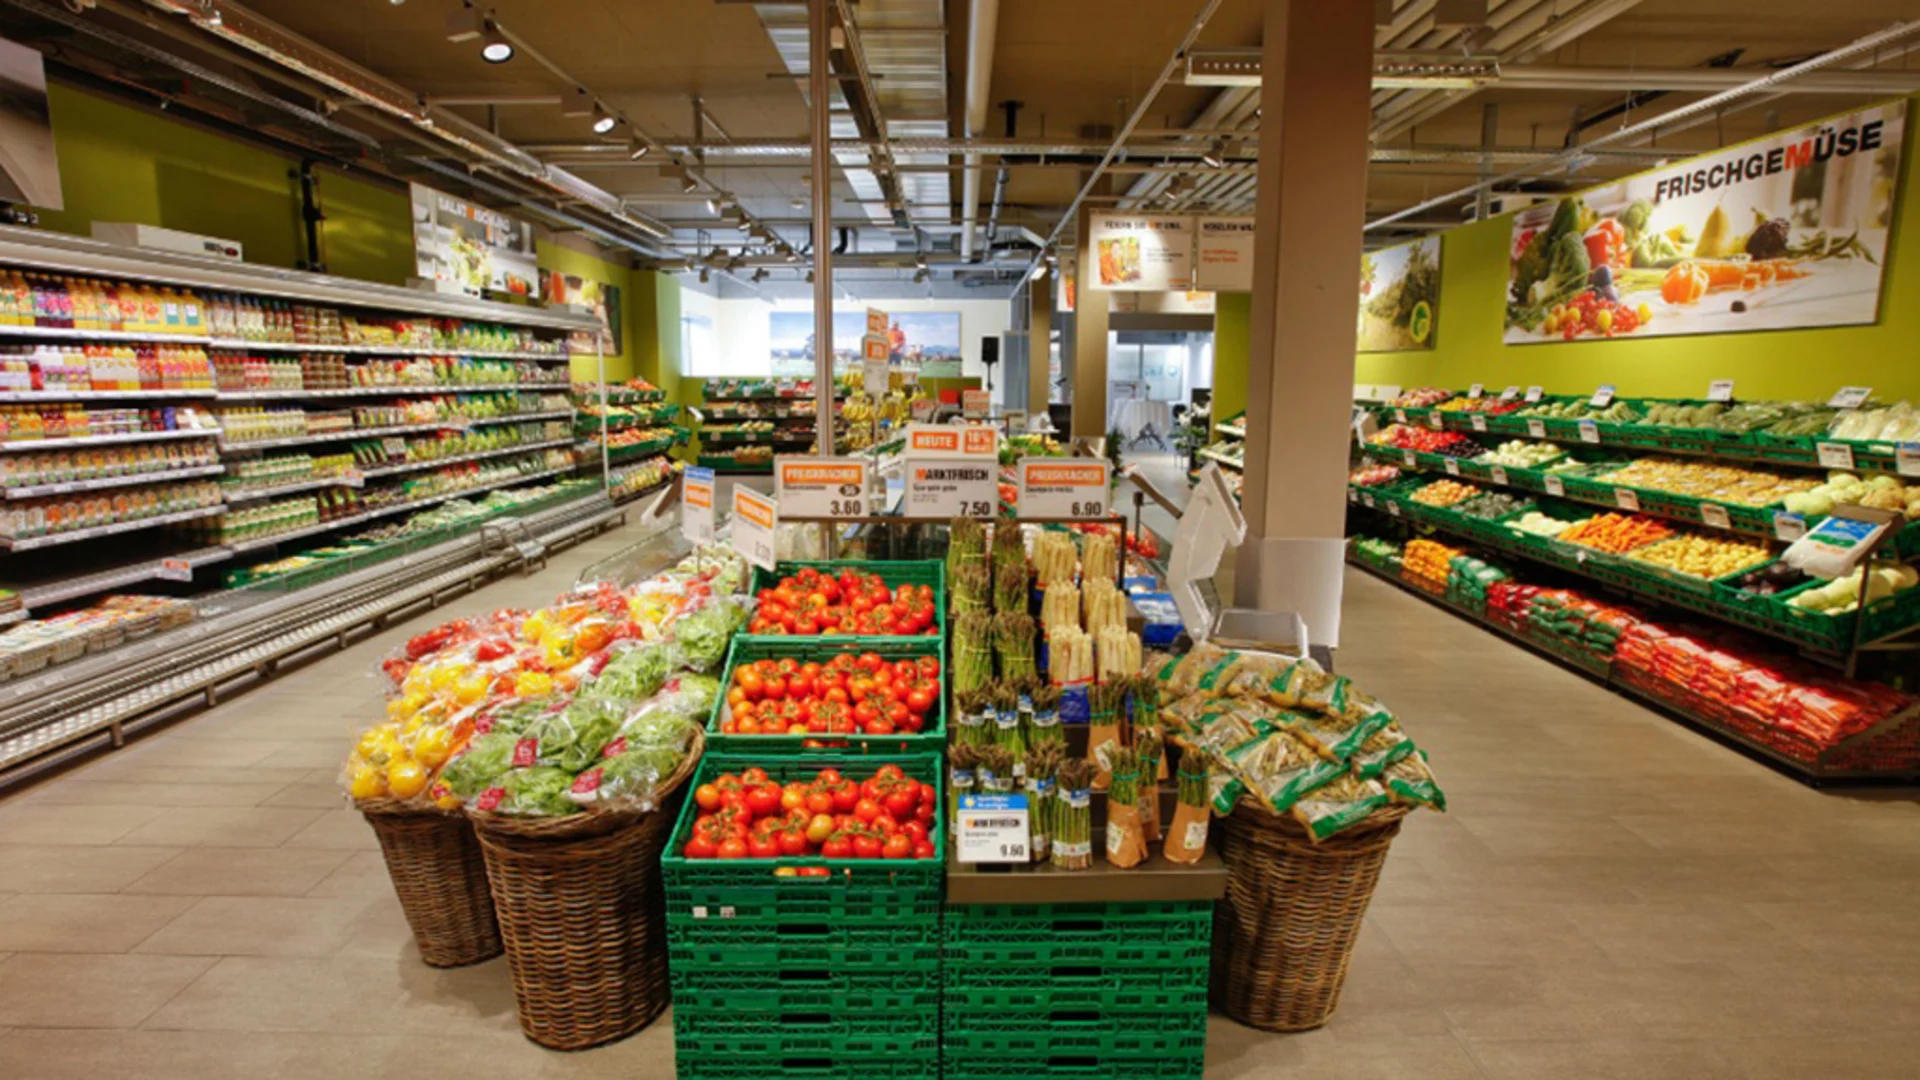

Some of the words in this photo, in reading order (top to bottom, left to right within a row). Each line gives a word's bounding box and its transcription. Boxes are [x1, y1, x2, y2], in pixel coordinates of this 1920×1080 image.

[1655, 120, 1883, 204] FRISCHGEMÜSE
[830, 500, 861, 515] 3.60
[959, 501, 991, 516] 7.50
